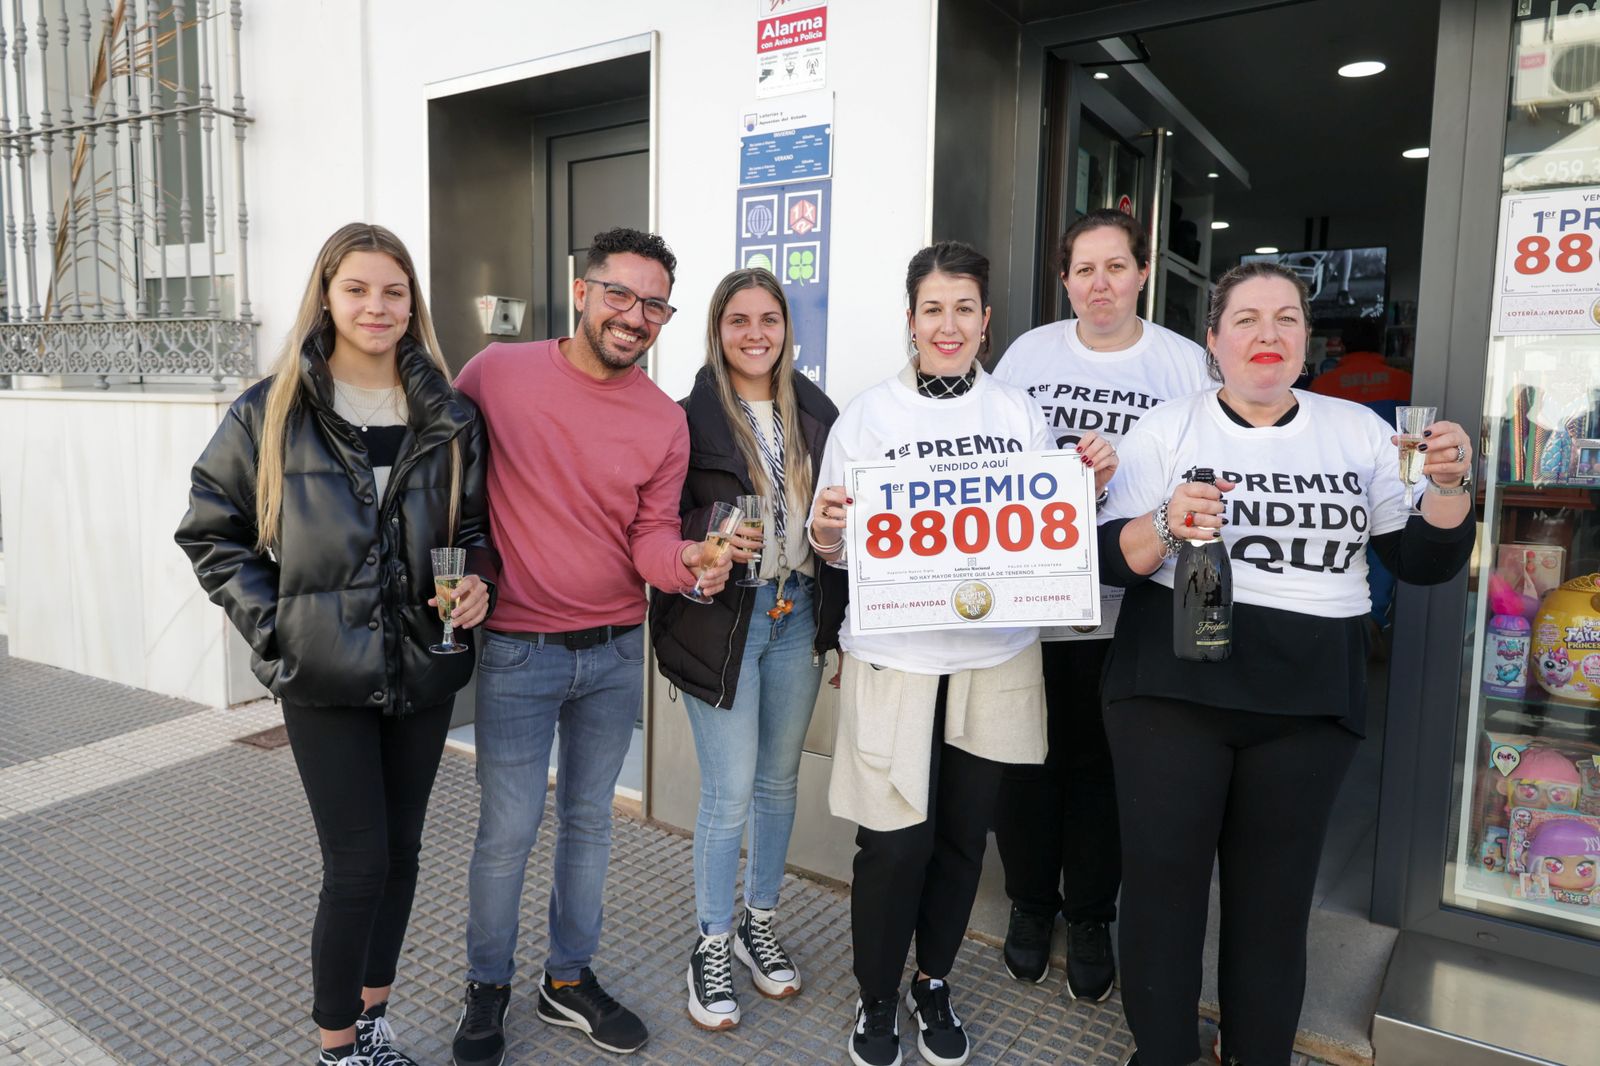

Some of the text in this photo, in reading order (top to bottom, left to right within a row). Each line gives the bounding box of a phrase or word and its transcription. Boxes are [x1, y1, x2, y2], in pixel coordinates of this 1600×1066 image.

[761, 15, 823, 40] Alarma
[761, 41, 773, 49] con
[774, 37, 793, 47] Aviso
[774, 154, 794, 162] VERANO
[1533, 210, 1556, 233] 1er
[1514, 233, 1600, 275] 88
[1507, 307, 1538, 317] LOTERÍA
[1548, 308, 1585, 316] NAVIDAD
[916, 434, 1023, 459] PREMIO
[929, 457, 1009, 473] VENDIDO AQUÍ
[879, 472, 1058, 510] 1er PREMIO
[1222, 471, 1363, 496] PREMIO
[865, 501, 1080, 559] 88008
[867, 601, 899, 611] LOTERÍA
[909, 599, 947, 608] NAVIDAD
[1025, 594, 1072, 602] DICIEMBRE
